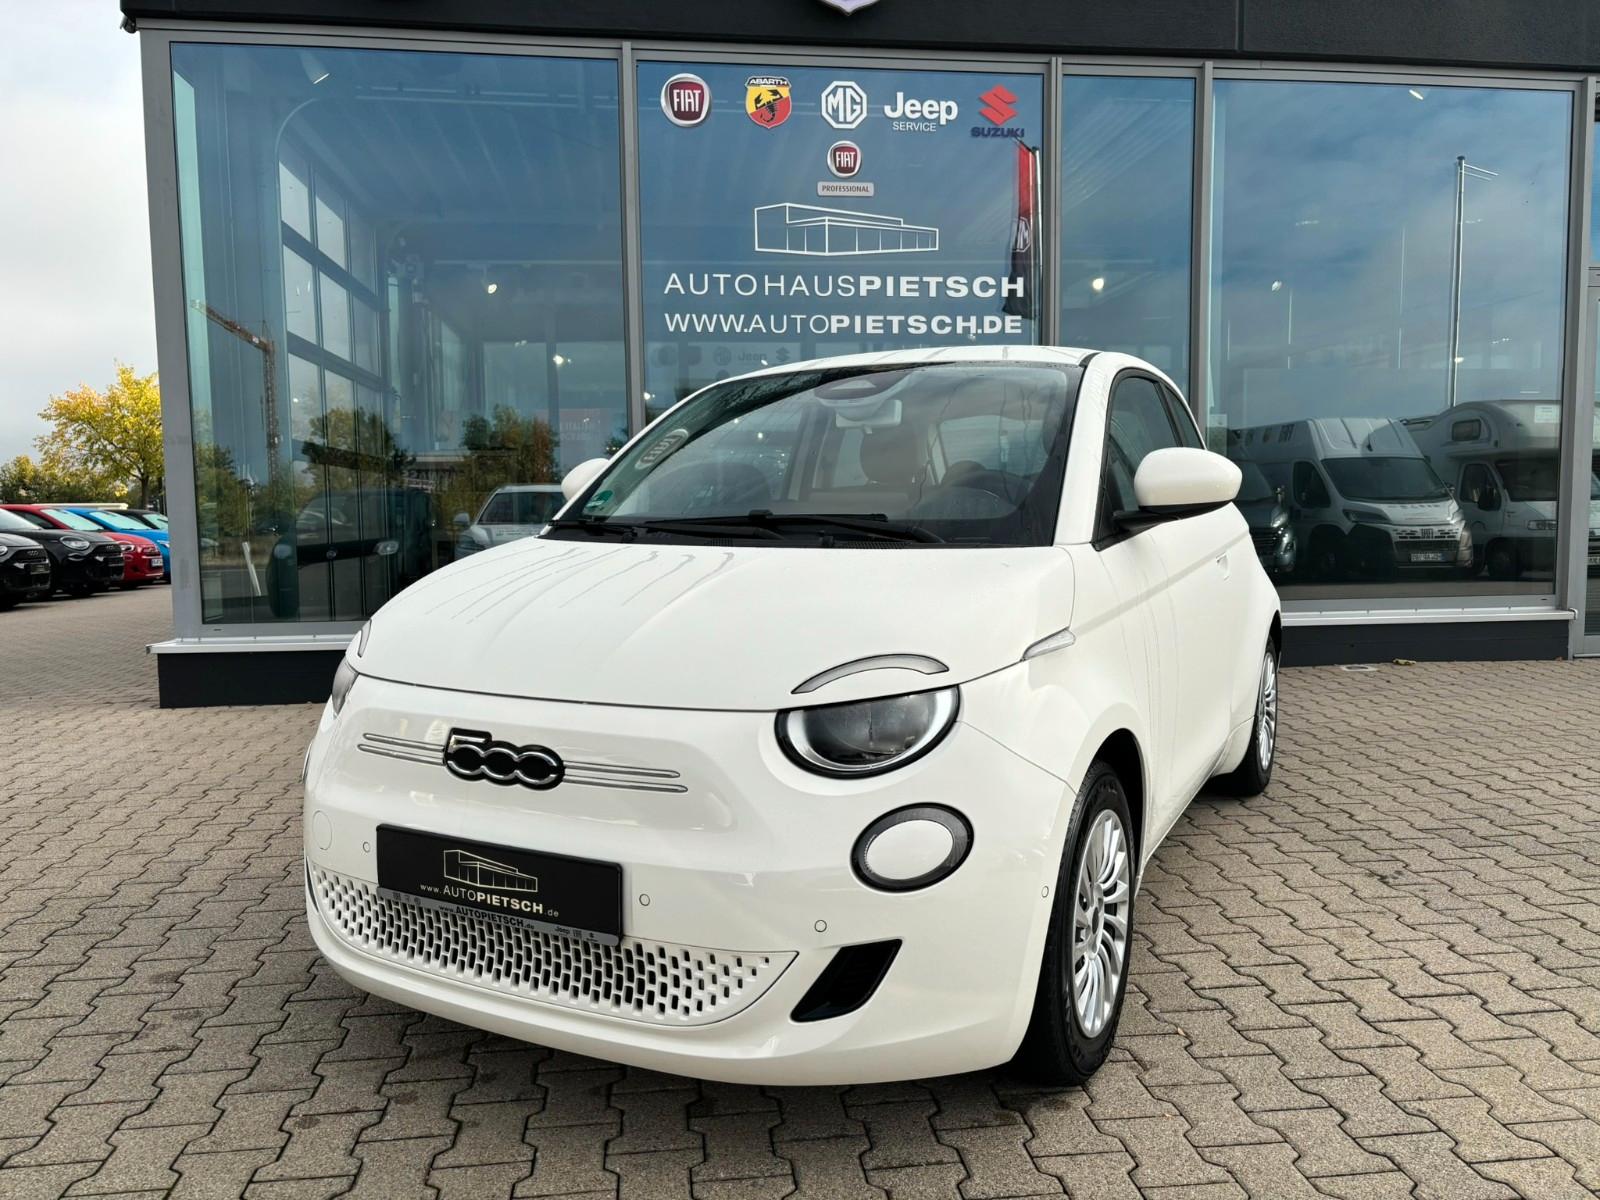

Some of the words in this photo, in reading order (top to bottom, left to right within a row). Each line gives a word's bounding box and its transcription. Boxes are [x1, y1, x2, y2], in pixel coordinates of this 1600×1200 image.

[749, 78, 788, 86] ABARTH
[673, 89, 702, 112] FIAT
[827, 87, 862, 123] MG
[884, 91, 959, 125] Jeep
[892, 121, 937, 132] SERVICE
[970, 126, 1025, 139] SUZUKI
[835, 151, 856, 168] FIAT
[821, 184, 870, 193] PROFESSIONAL
[664, 272, 1024, 298] AUTOHAUSPIETSCH
[664, 312, 1022, 334] WWW.AUTOPIETSCH.DE
[444, 727, 566, 791] 500
